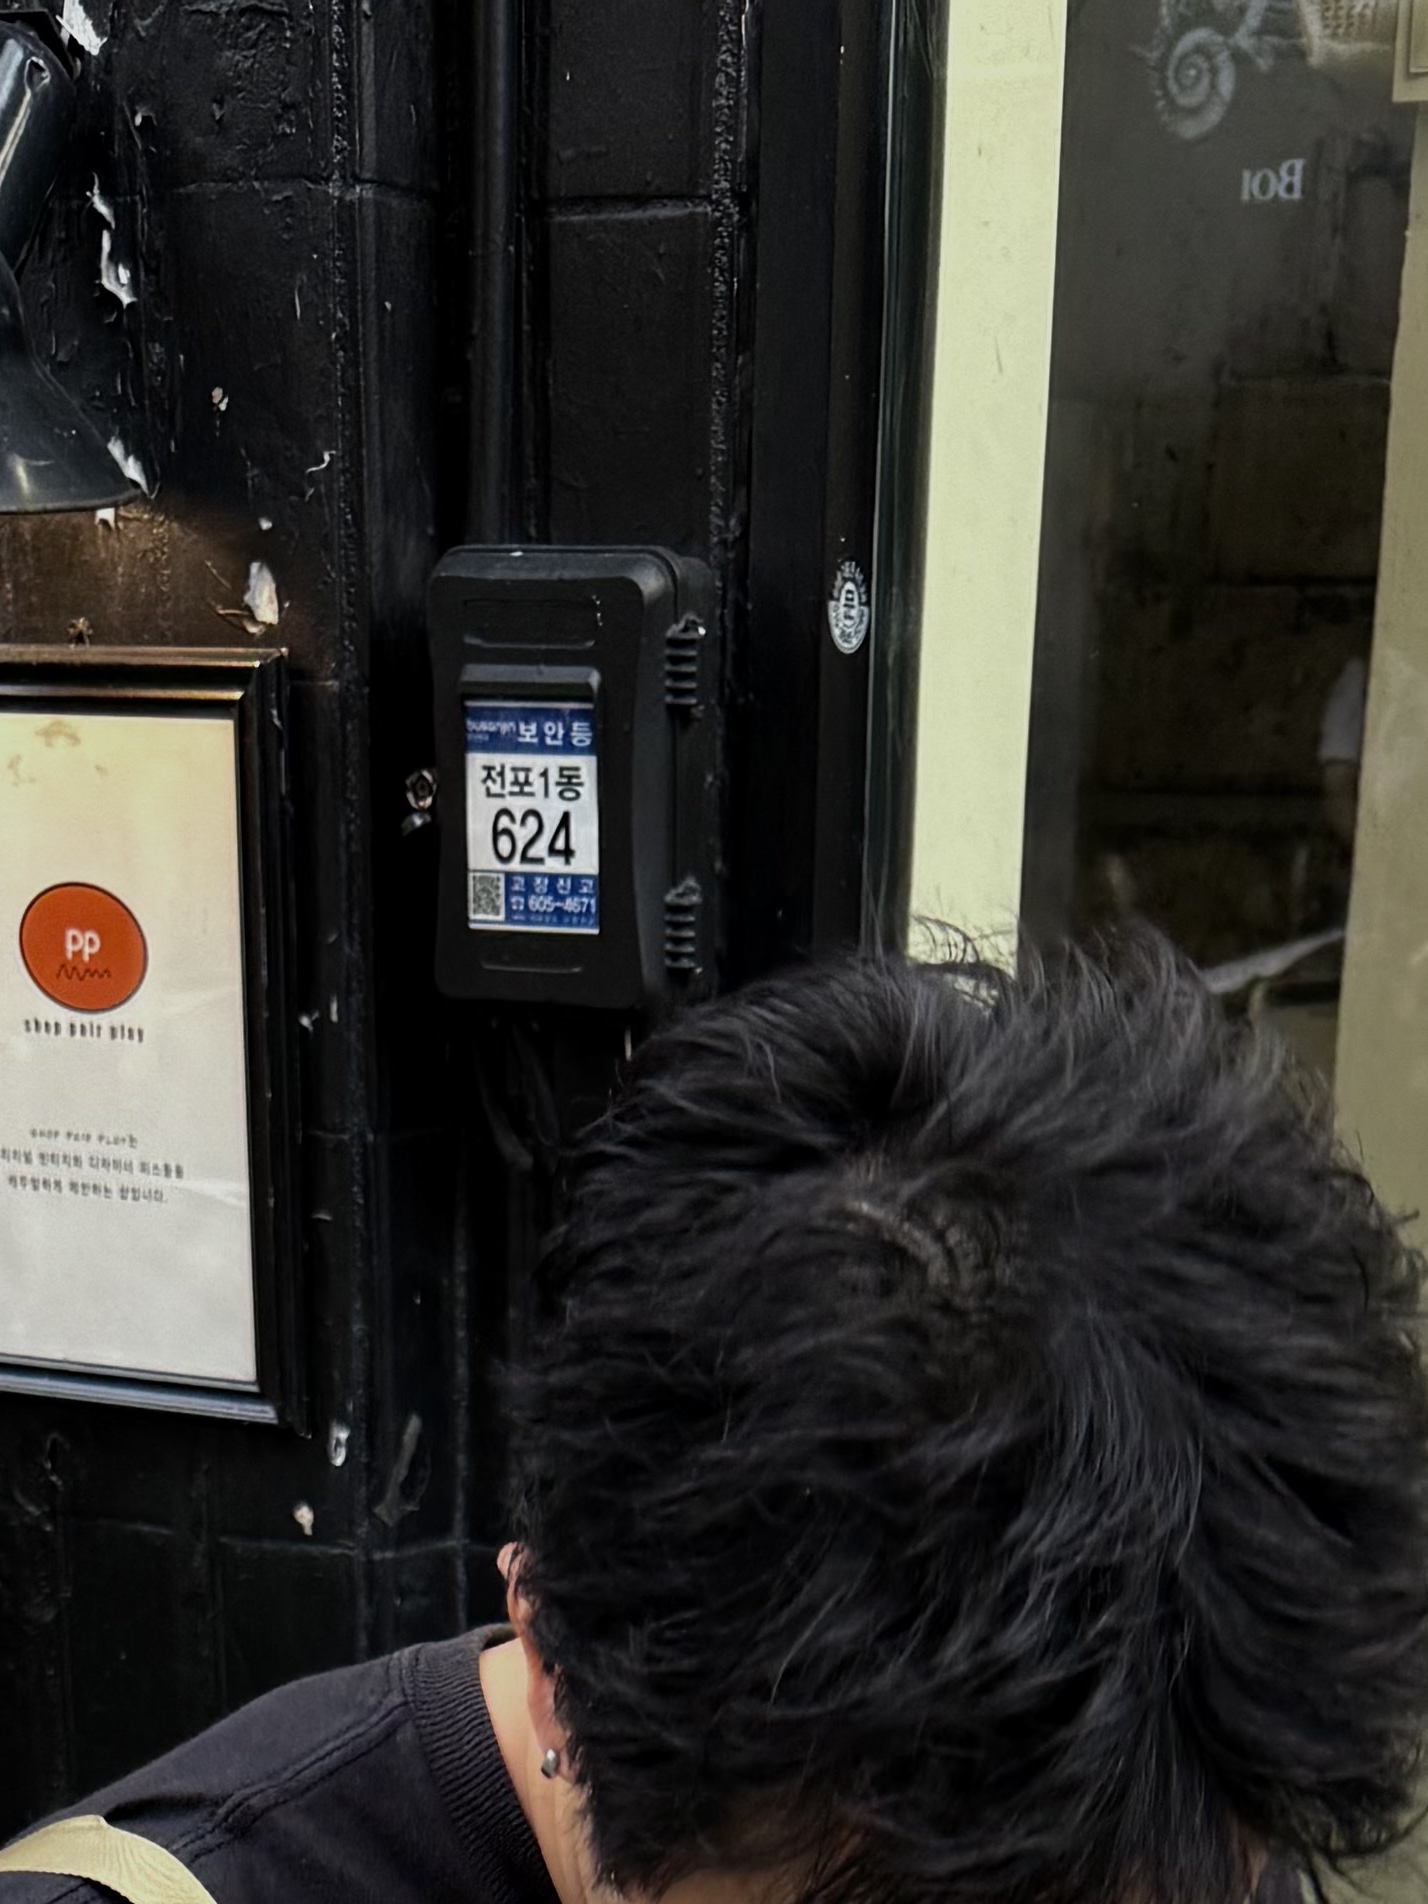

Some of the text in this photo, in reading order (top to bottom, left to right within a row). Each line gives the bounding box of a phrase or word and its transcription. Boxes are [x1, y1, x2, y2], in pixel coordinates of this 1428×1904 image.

[517, 719, 593, 748] 보안등
[481, 763, 585, 802] 전포1동
[491, 807, 576, 866] 624
